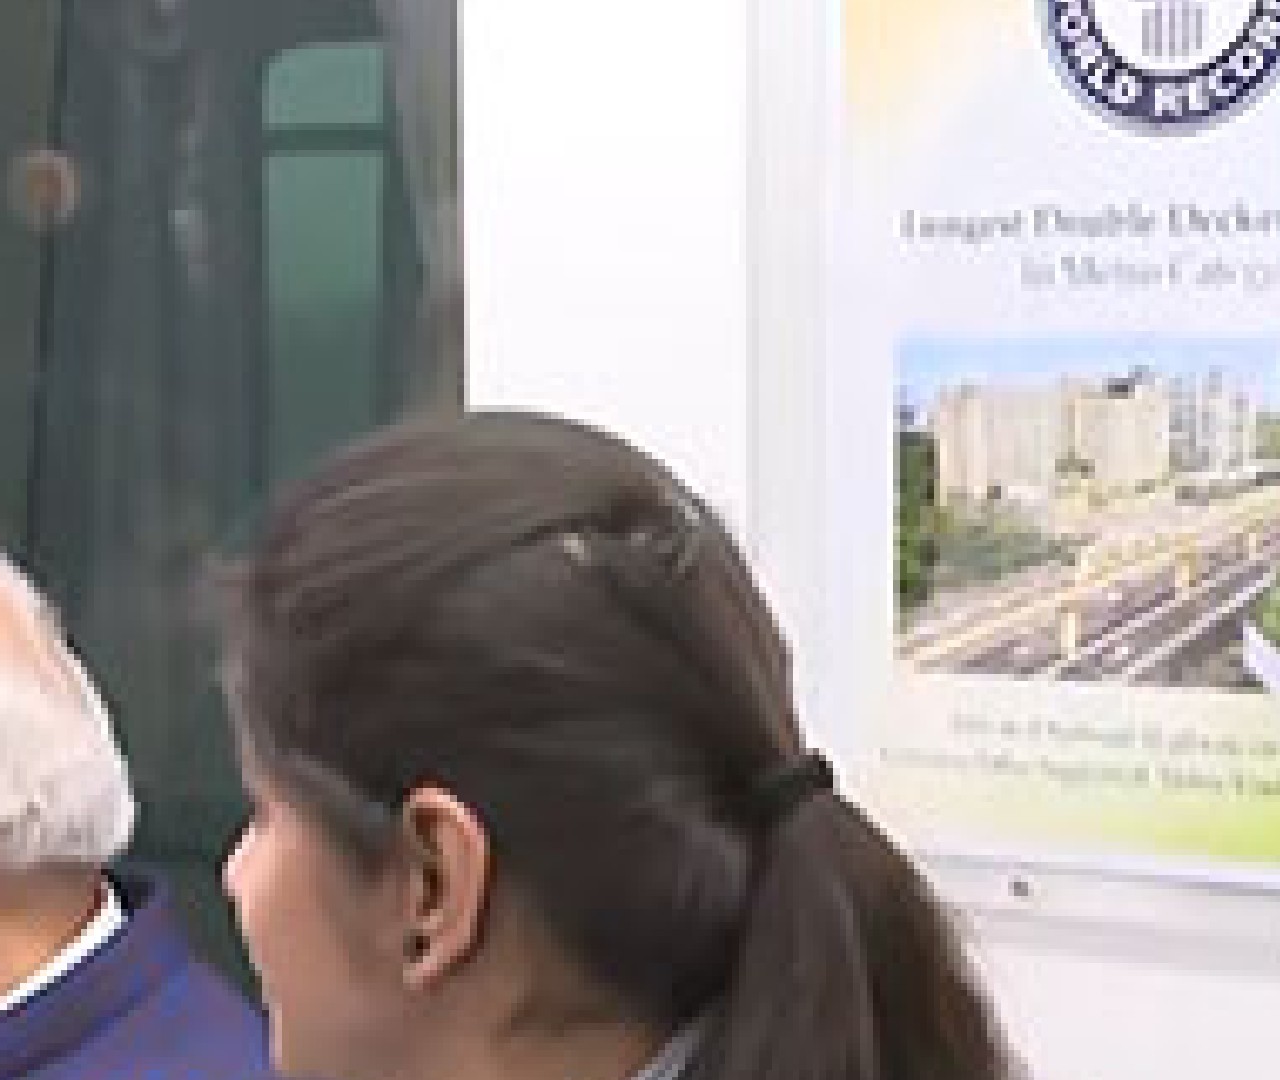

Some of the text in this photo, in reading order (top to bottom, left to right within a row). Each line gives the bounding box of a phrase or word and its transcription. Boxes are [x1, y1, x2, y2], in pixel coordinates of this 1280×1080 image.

[1056, 0, 1280, 119] ORLD RECOR
[1032, 202, 1157, 239] Double
